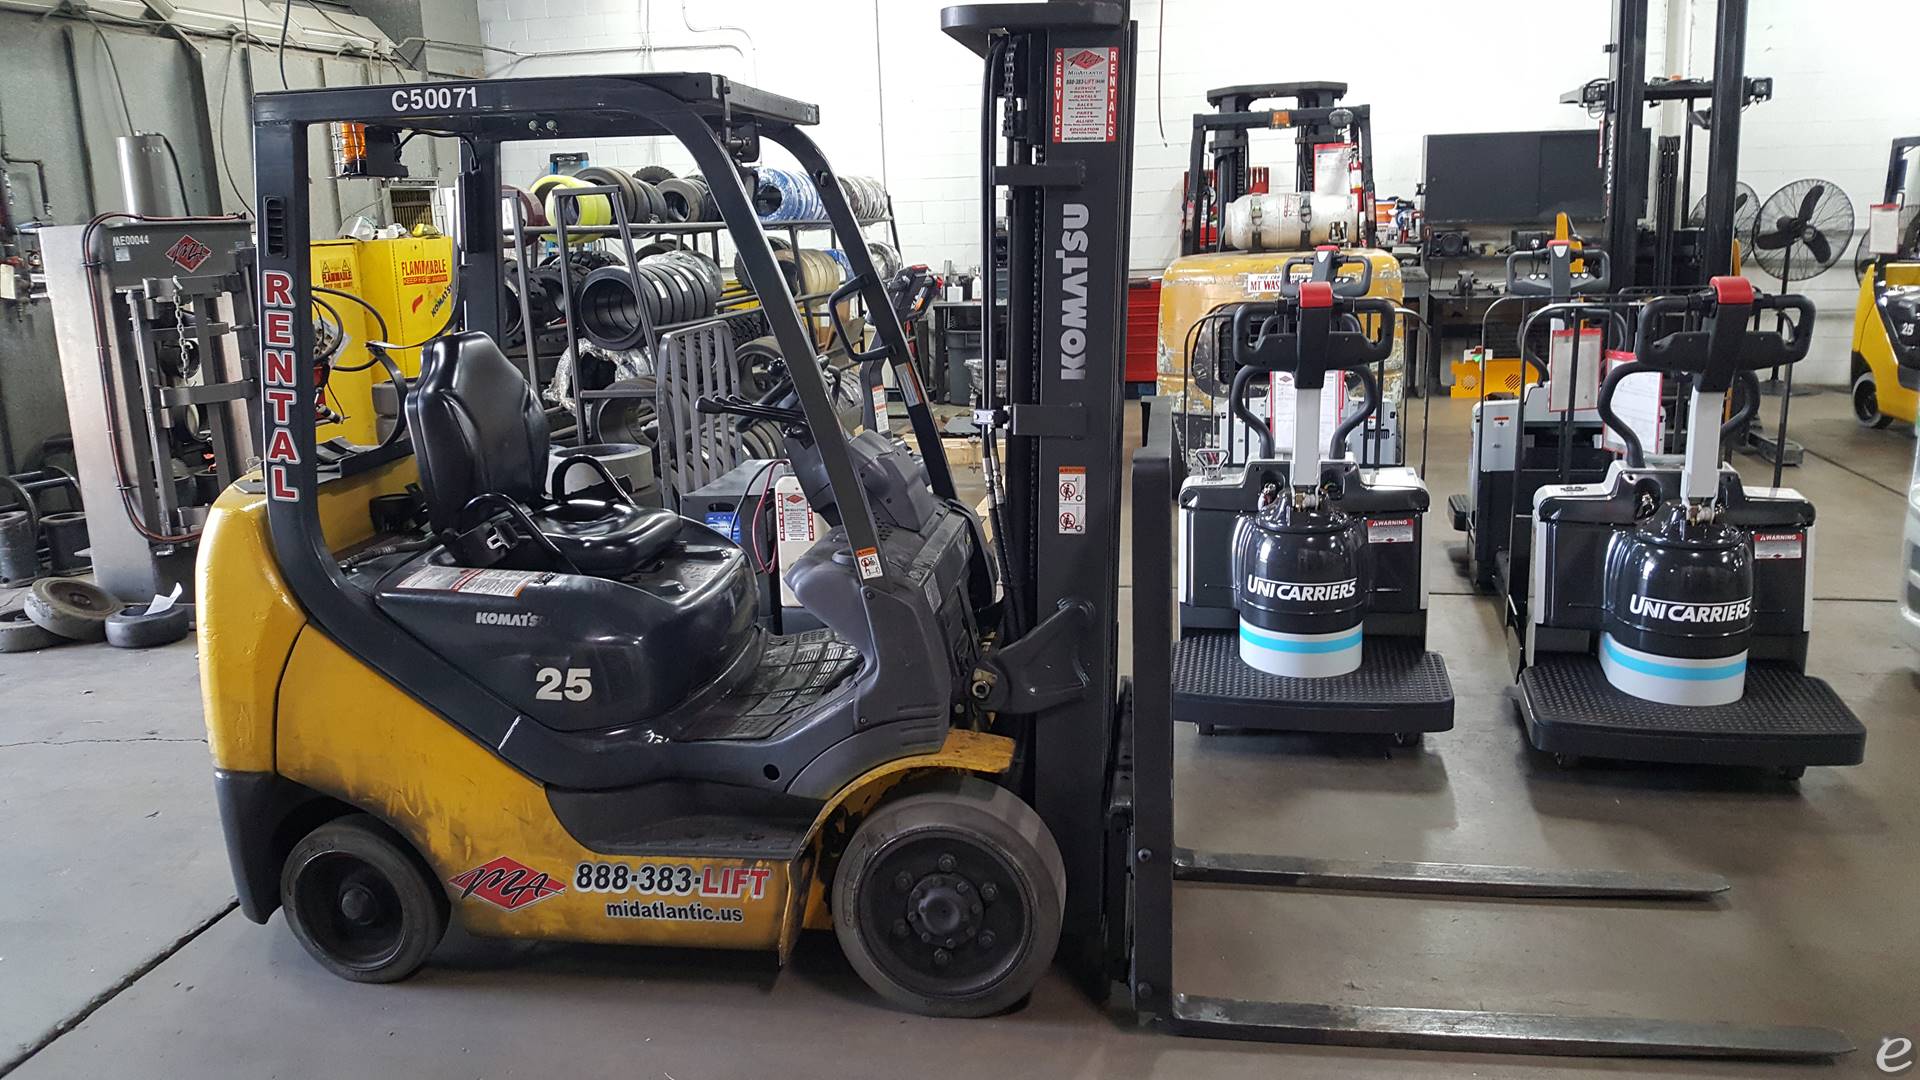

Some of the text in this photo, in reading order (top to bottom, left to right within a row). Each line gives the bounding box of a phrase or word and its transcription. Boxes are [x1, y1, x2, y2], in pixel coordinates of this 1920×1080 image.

[391, 86, 477, 112] C50071
[1054, 52, 1062, 137] SERVICE
[1108, 51, 1117, 137] RENTALS
[112, 235, 150, 247] ME00044
[401, 259, 447, 276] FLAMMABLE
[430, 283, 453, 318] KOMATS
[1055, 203, 1089, 380] KOMATSU
[263, 270, 300, 502] RENTAL
[475, 612, 543, 628] KOMATS
[535, 667, 593, 702] 25
[606, 899, 744, 922] midatlantic.us
